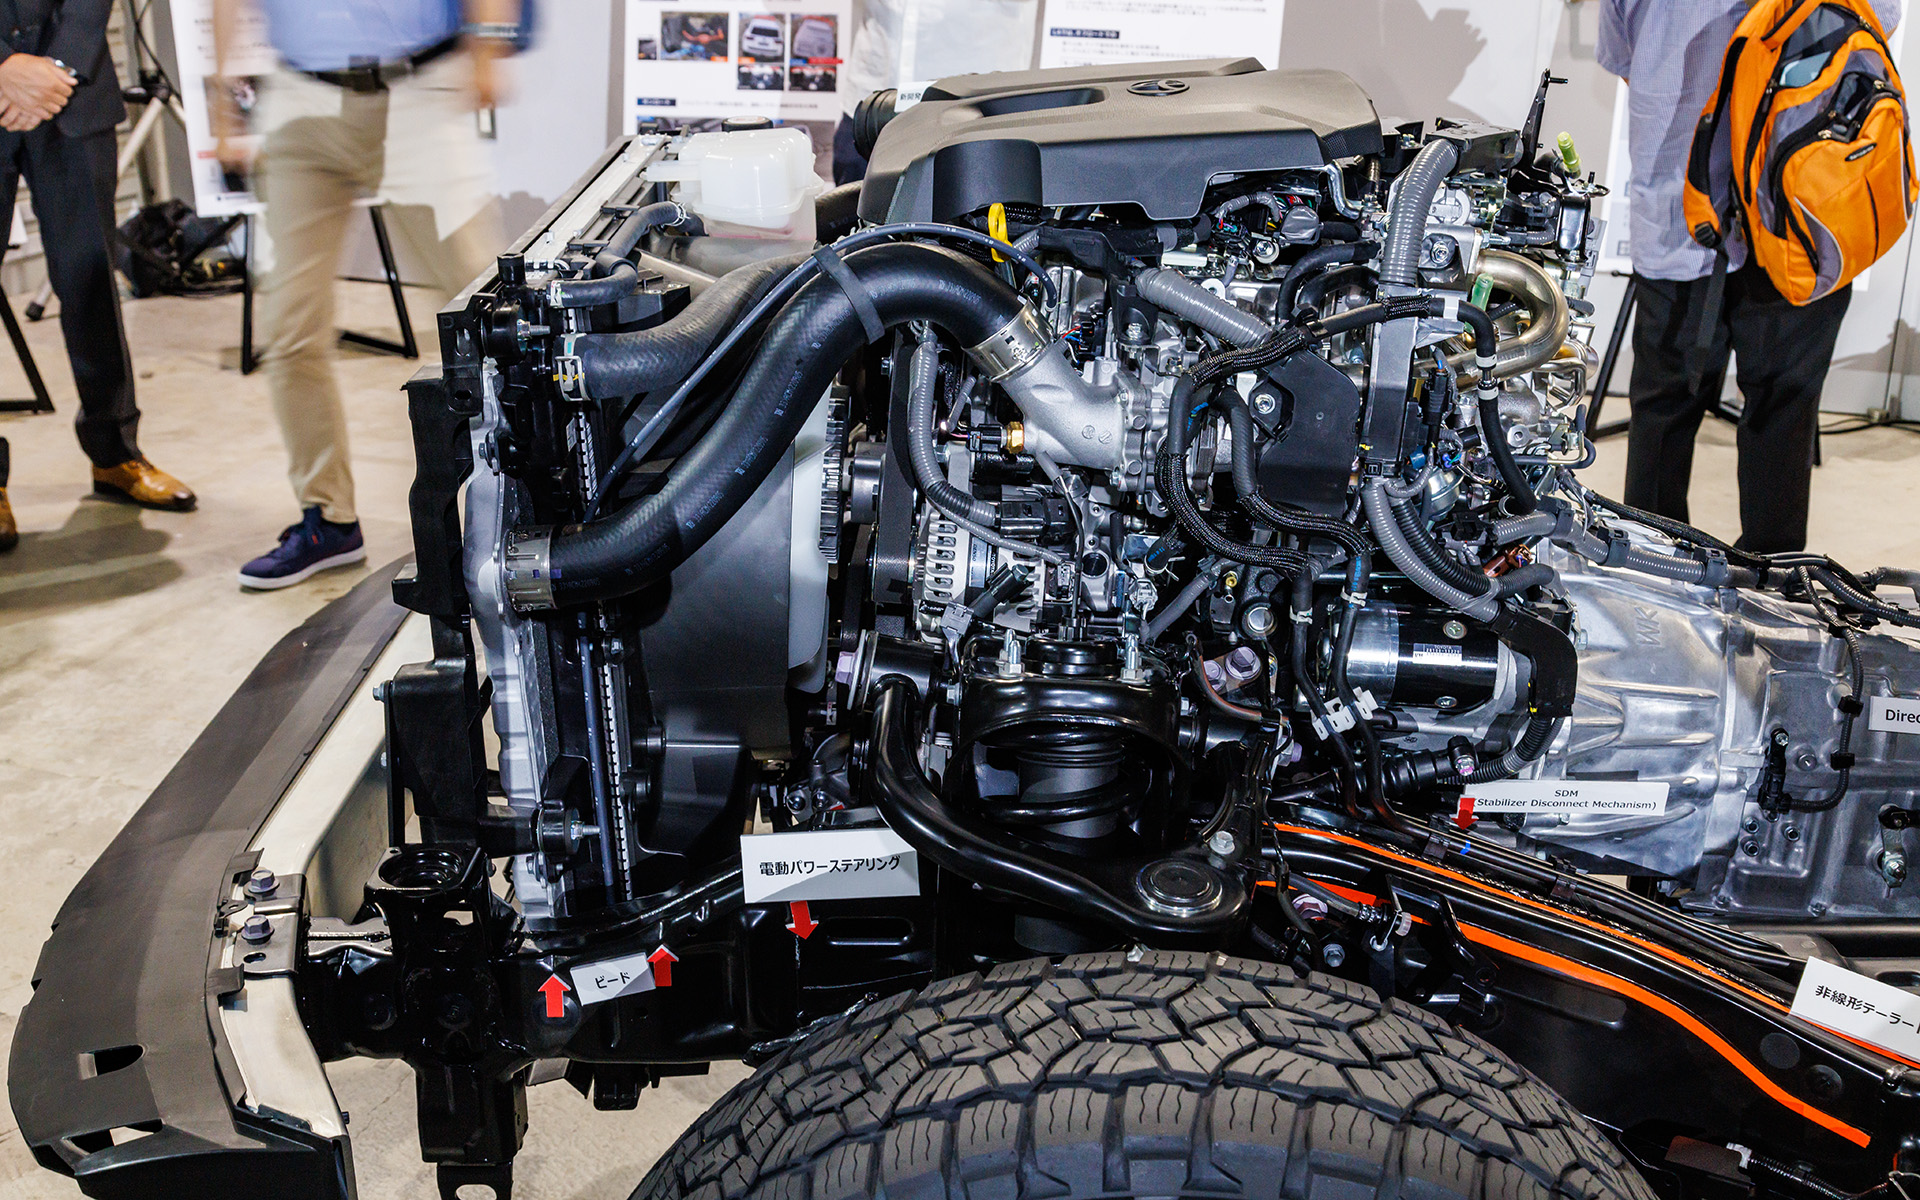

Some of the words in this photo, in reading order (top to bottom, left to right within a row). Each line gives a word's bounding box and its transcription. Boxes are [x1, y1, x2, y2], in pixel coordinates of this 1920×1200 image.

[1554, 789, 1579, 798] SDM
[1475, 798, 1527, 808] Stabilizer
[1530, 799, 1588, 808] Disconnect
[1592, 800, 1657, 811] Mechanism)
[759, 855, 901, 876] 電動パワーステアリング
[595, 971, 631, 989] ビード
[1815, 985, 1920, 1034] 非線形テーラー
